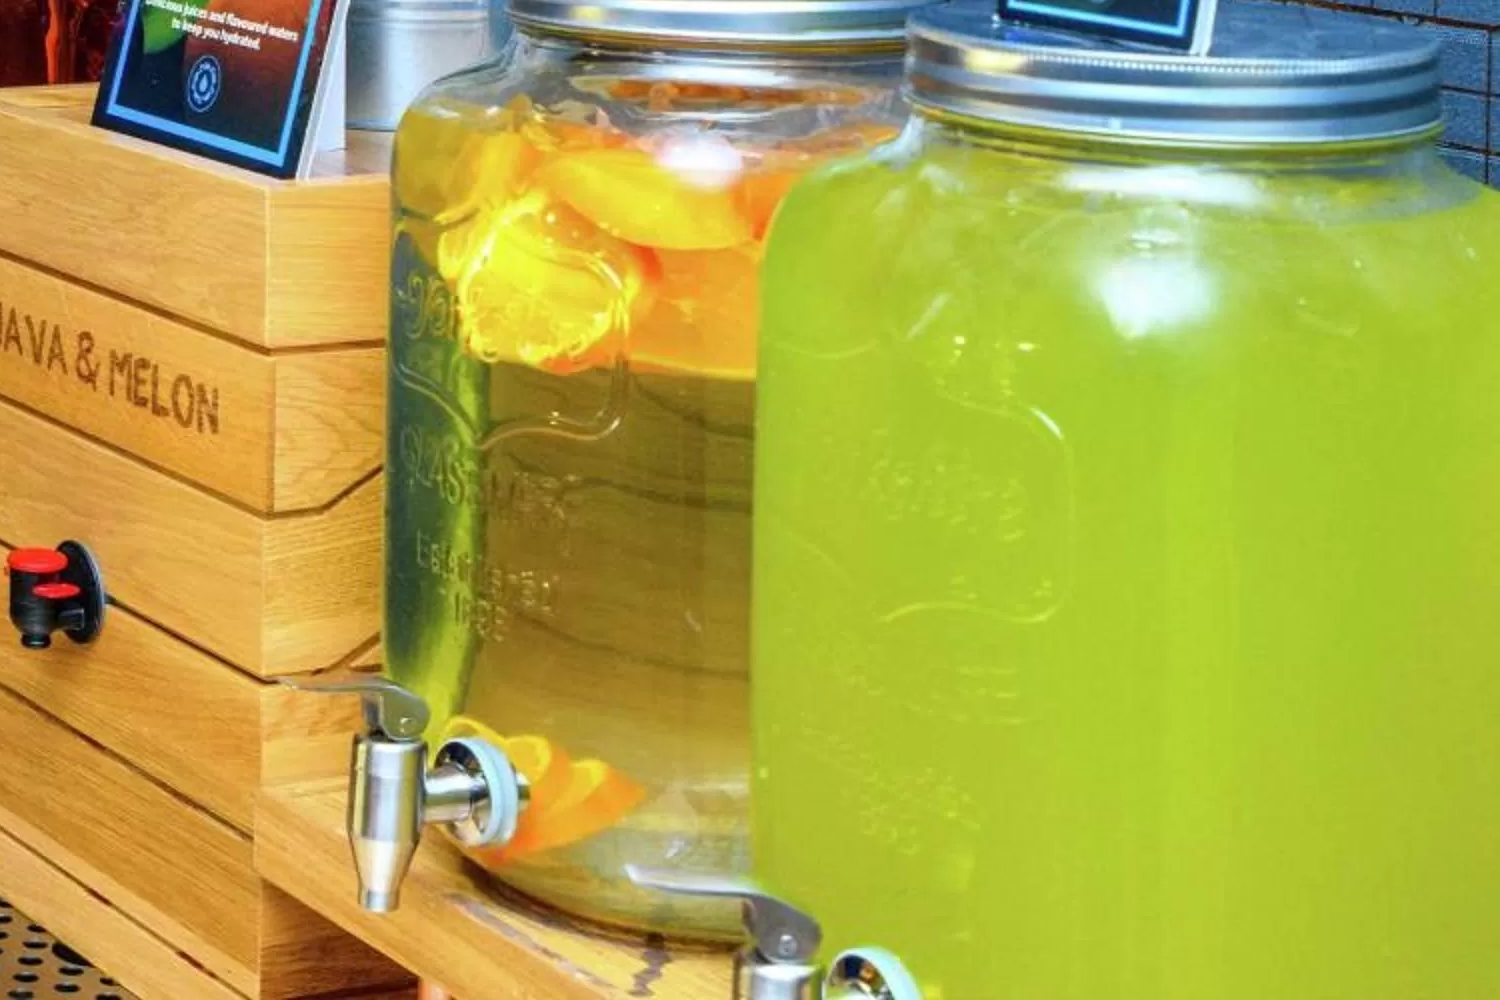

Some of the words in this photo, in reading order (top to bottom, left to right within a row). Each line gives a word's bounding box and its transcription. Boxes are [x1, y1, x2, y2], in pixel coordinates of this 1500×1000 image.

[171, 17, 181, 29] to
[182, 20, 203, 37] keep
[203, 28, 220, 39] you
[182, 1, 208, 18] juices
[208, 11, 227, 23] and
[227, 13, 269, 34] flavoured
[268, 26, 299, 42] waters
[75, 330, 101, 392] &
[108, 349, 220, 435] MELON
